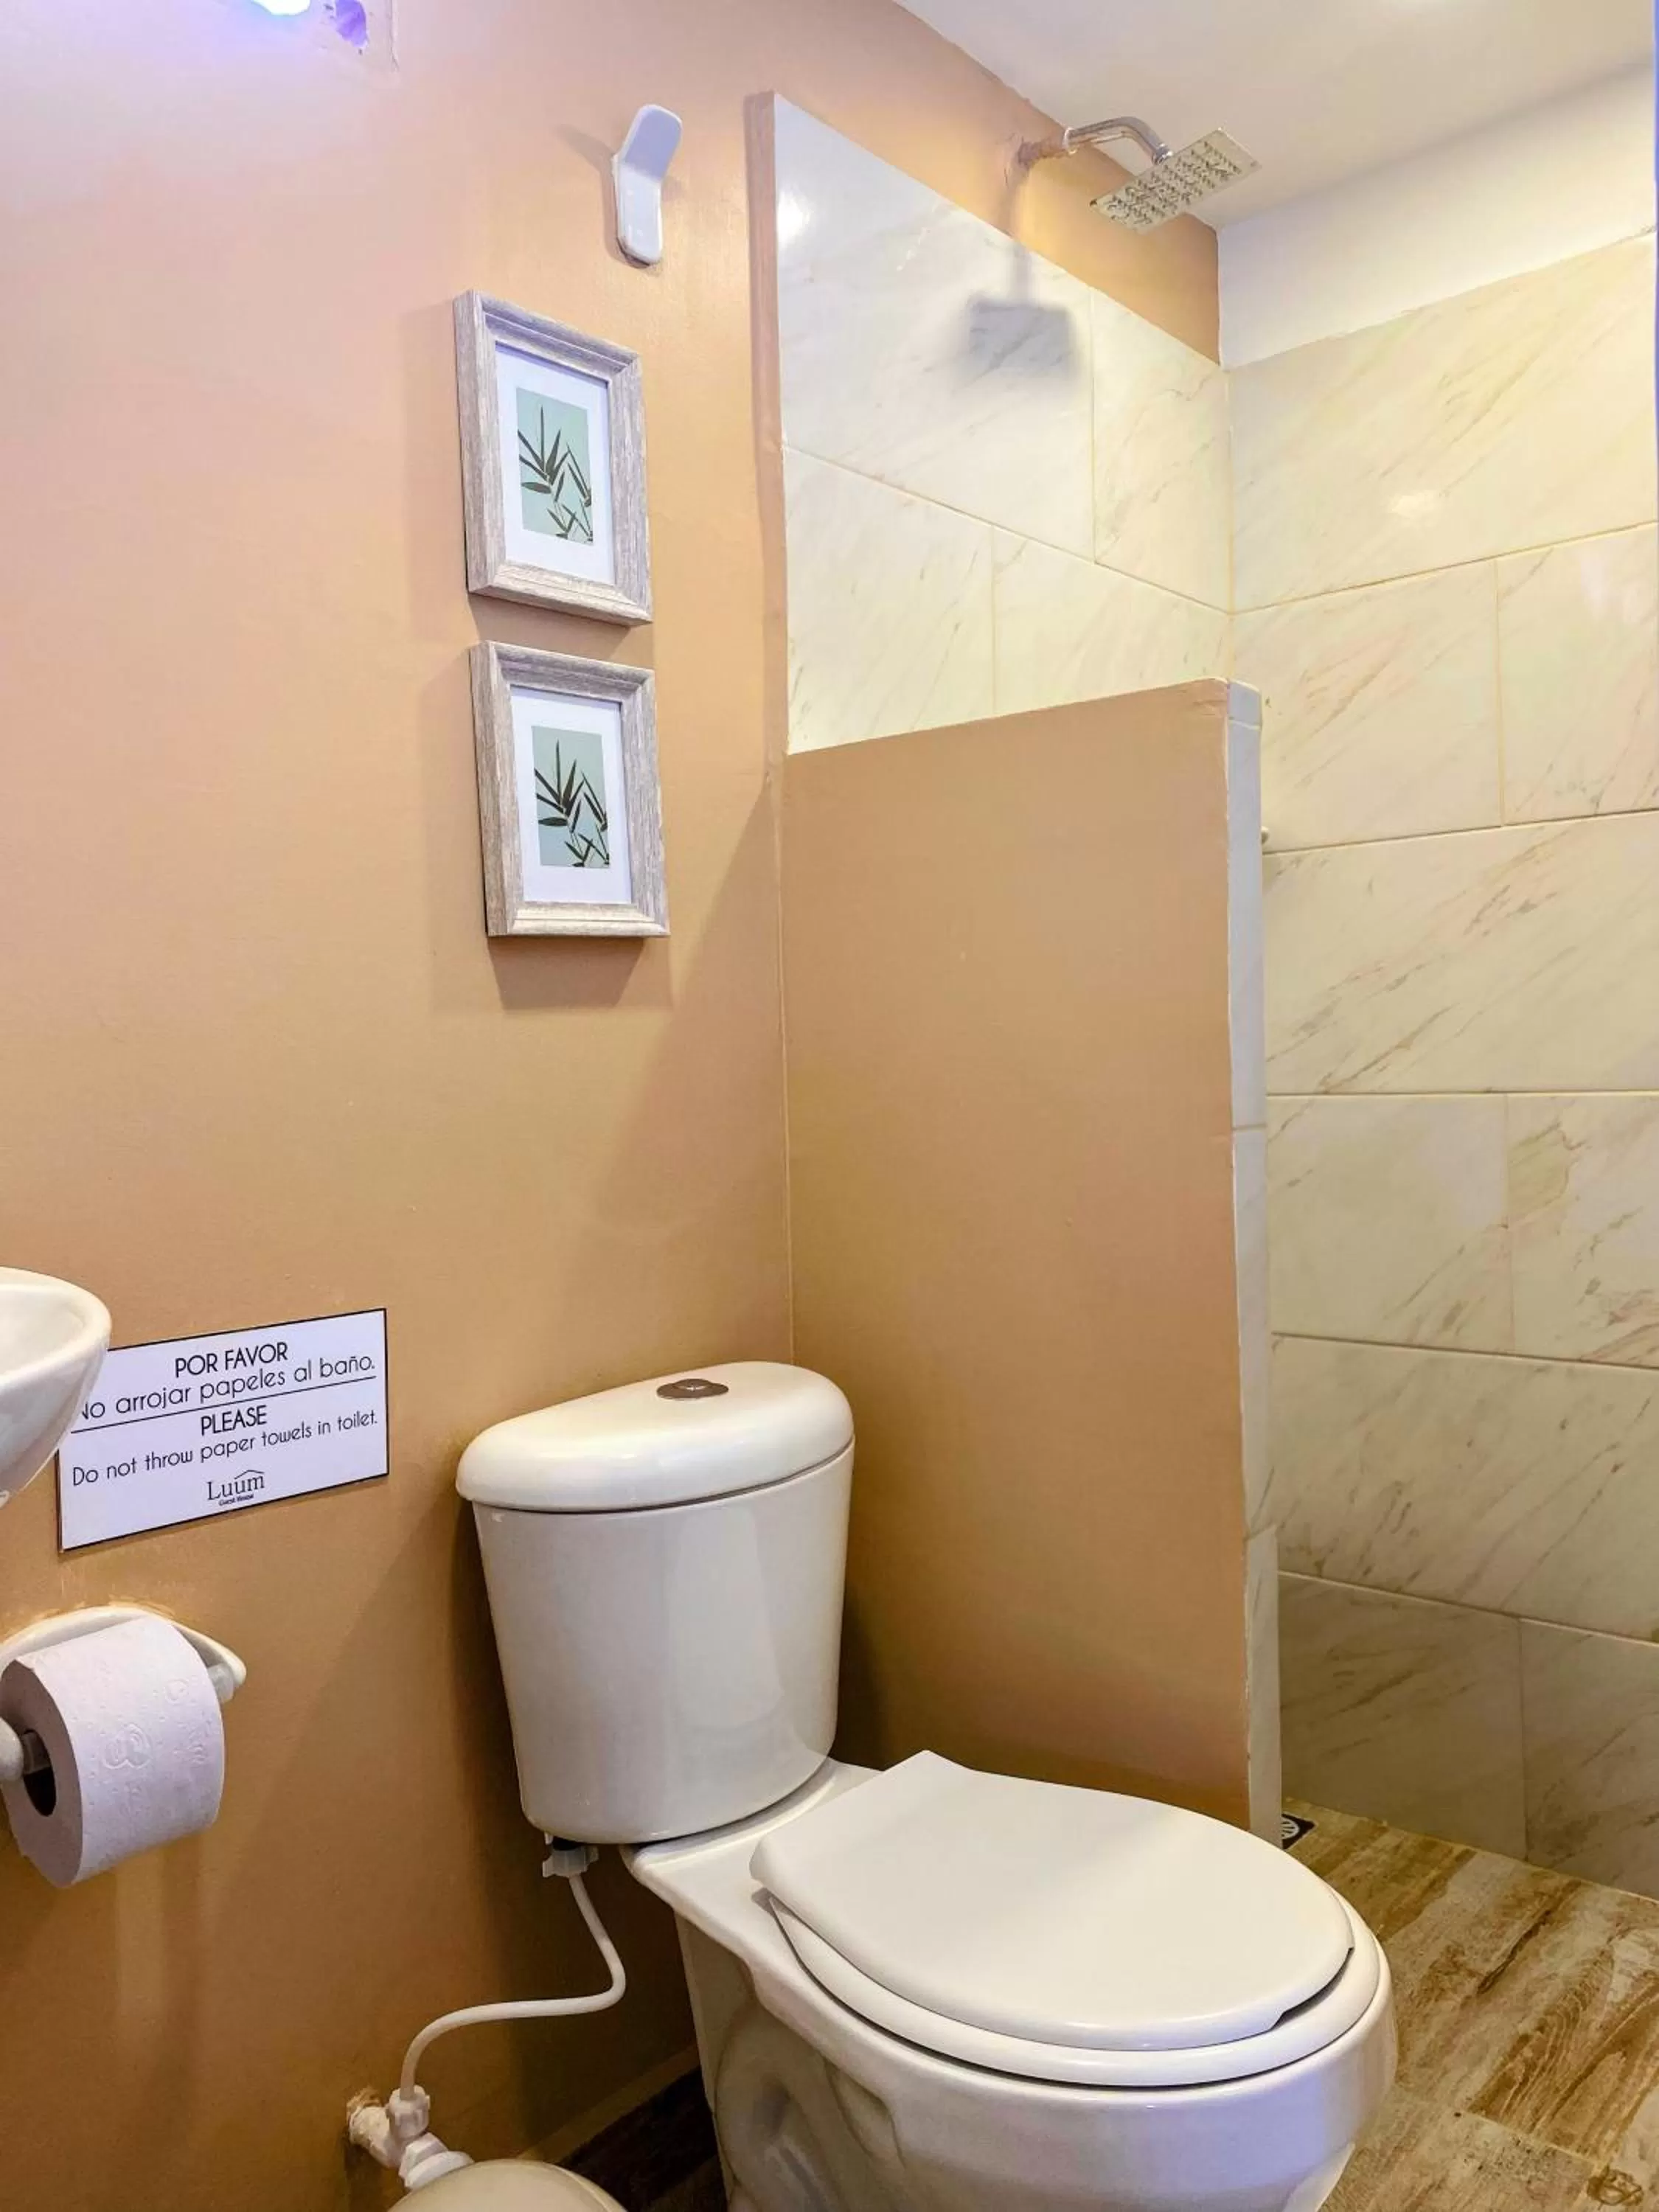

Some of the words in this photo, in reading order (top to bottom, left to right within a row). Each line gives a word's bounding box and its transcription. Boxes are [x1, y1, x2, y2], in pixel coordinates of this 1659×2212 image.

[175, 1353, 218, 1377] POR
[225, 1342, 288, 1371] FAVOR
[116, 1387, 191, 1413] arrojar
[201, 1368, 285, 1403] papeles
[294, 1359, 312, 1382] al
[320, 1356, 375, 1378] baño.
[201, 1405, 268, 1436] PLEASE
[73, 1467, 98, 1486] Do
[107, 1458, 136, 1479] not
[145, 1450, 193, 1471] throw
[201, 1437, 256, 1463] paper
[261, 1420, 312, 1447] towels
[318, 1421, 330, 1435] in
[338, 1409, 378, 1431] toilet.
[207, 1476, 265, 1500] Luum
